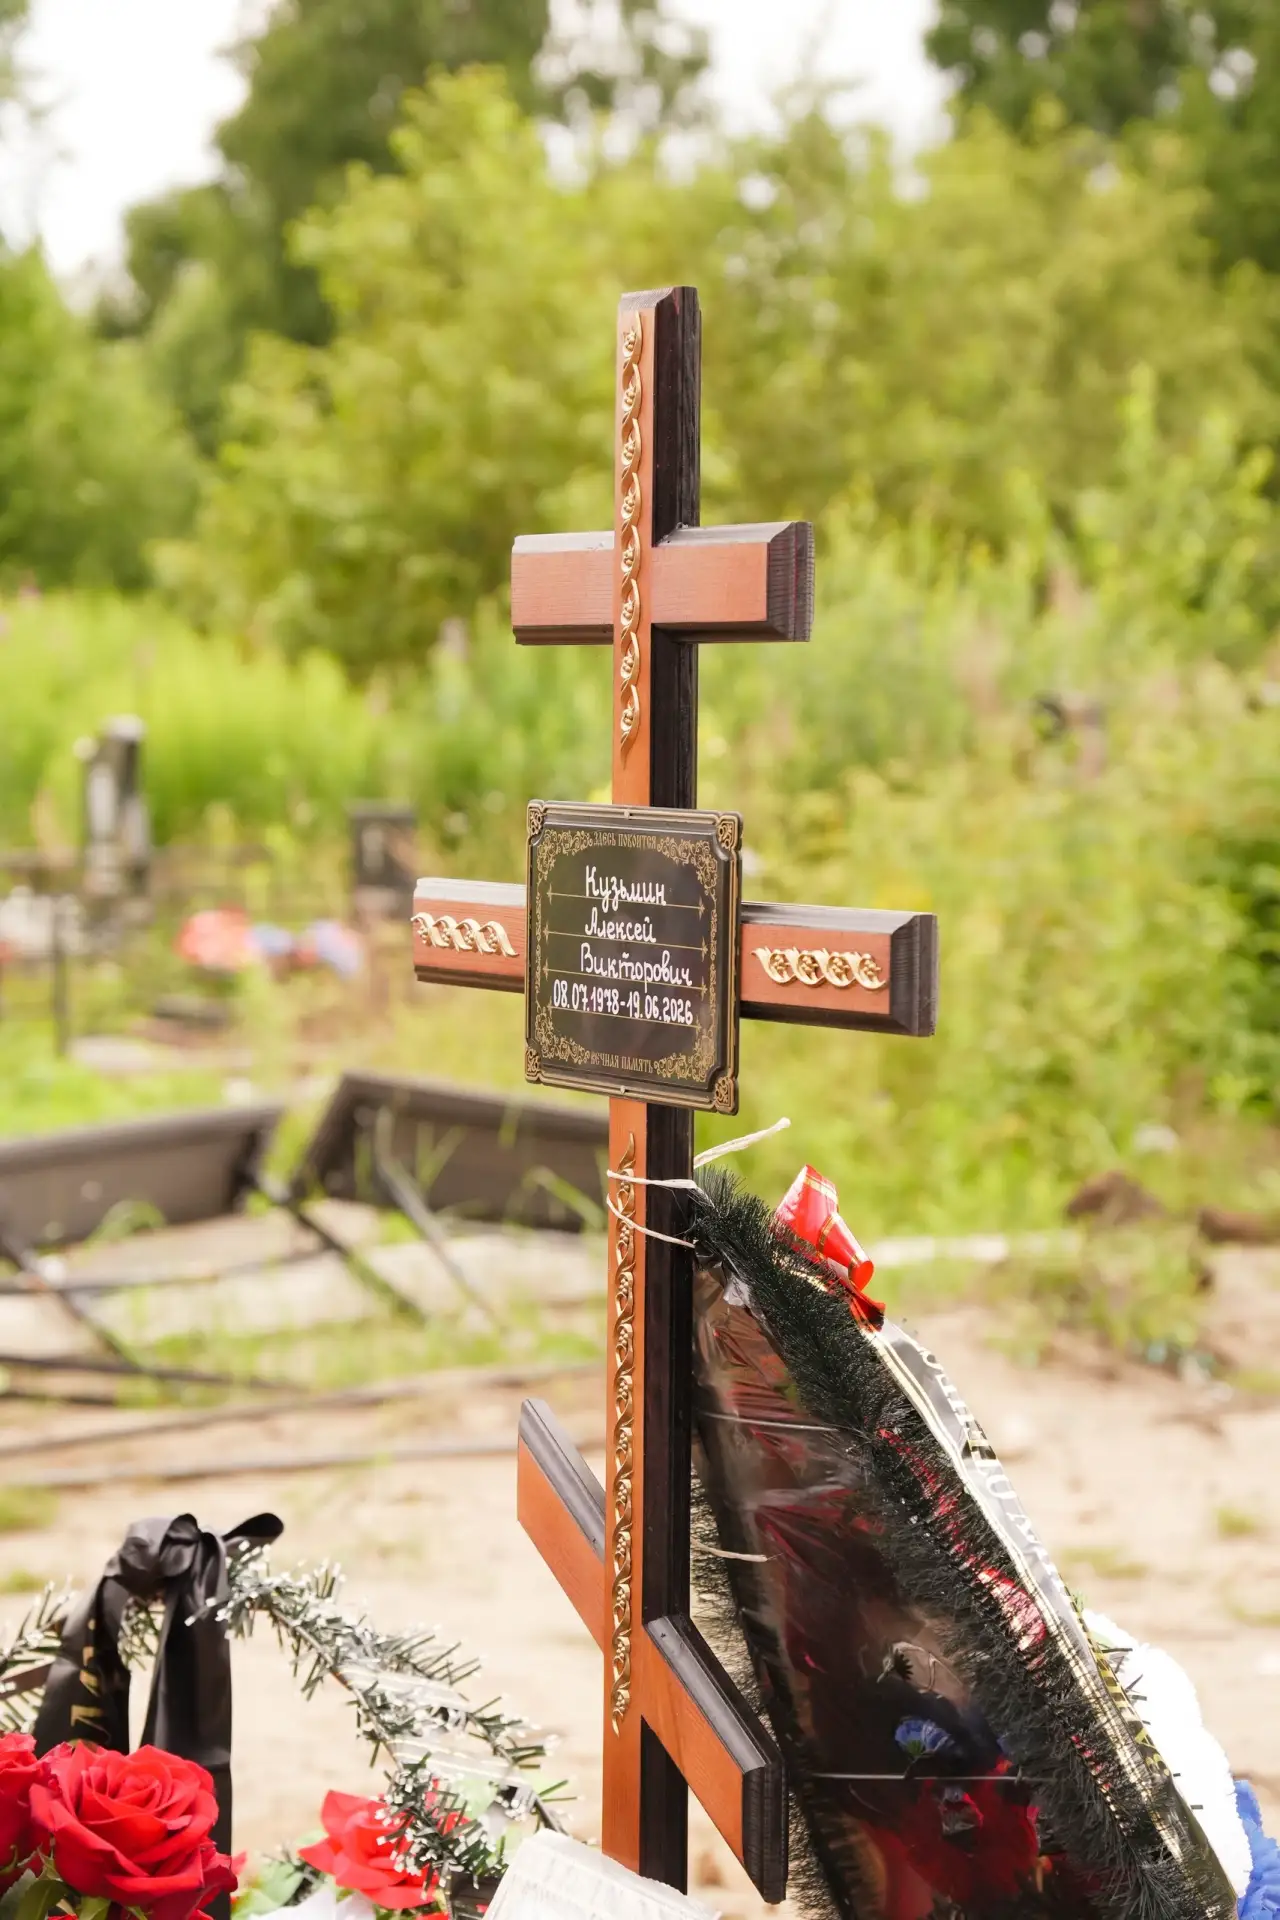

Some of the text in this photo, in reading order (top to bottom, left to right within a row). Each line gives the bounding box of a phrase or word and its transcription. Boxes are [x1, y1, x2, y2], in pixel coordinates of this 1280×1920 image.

[585, 865, 667, 913] Кузьмин
[584, 906, 657, 943] Алексей
[580, 942, 692, 992] Викторович
